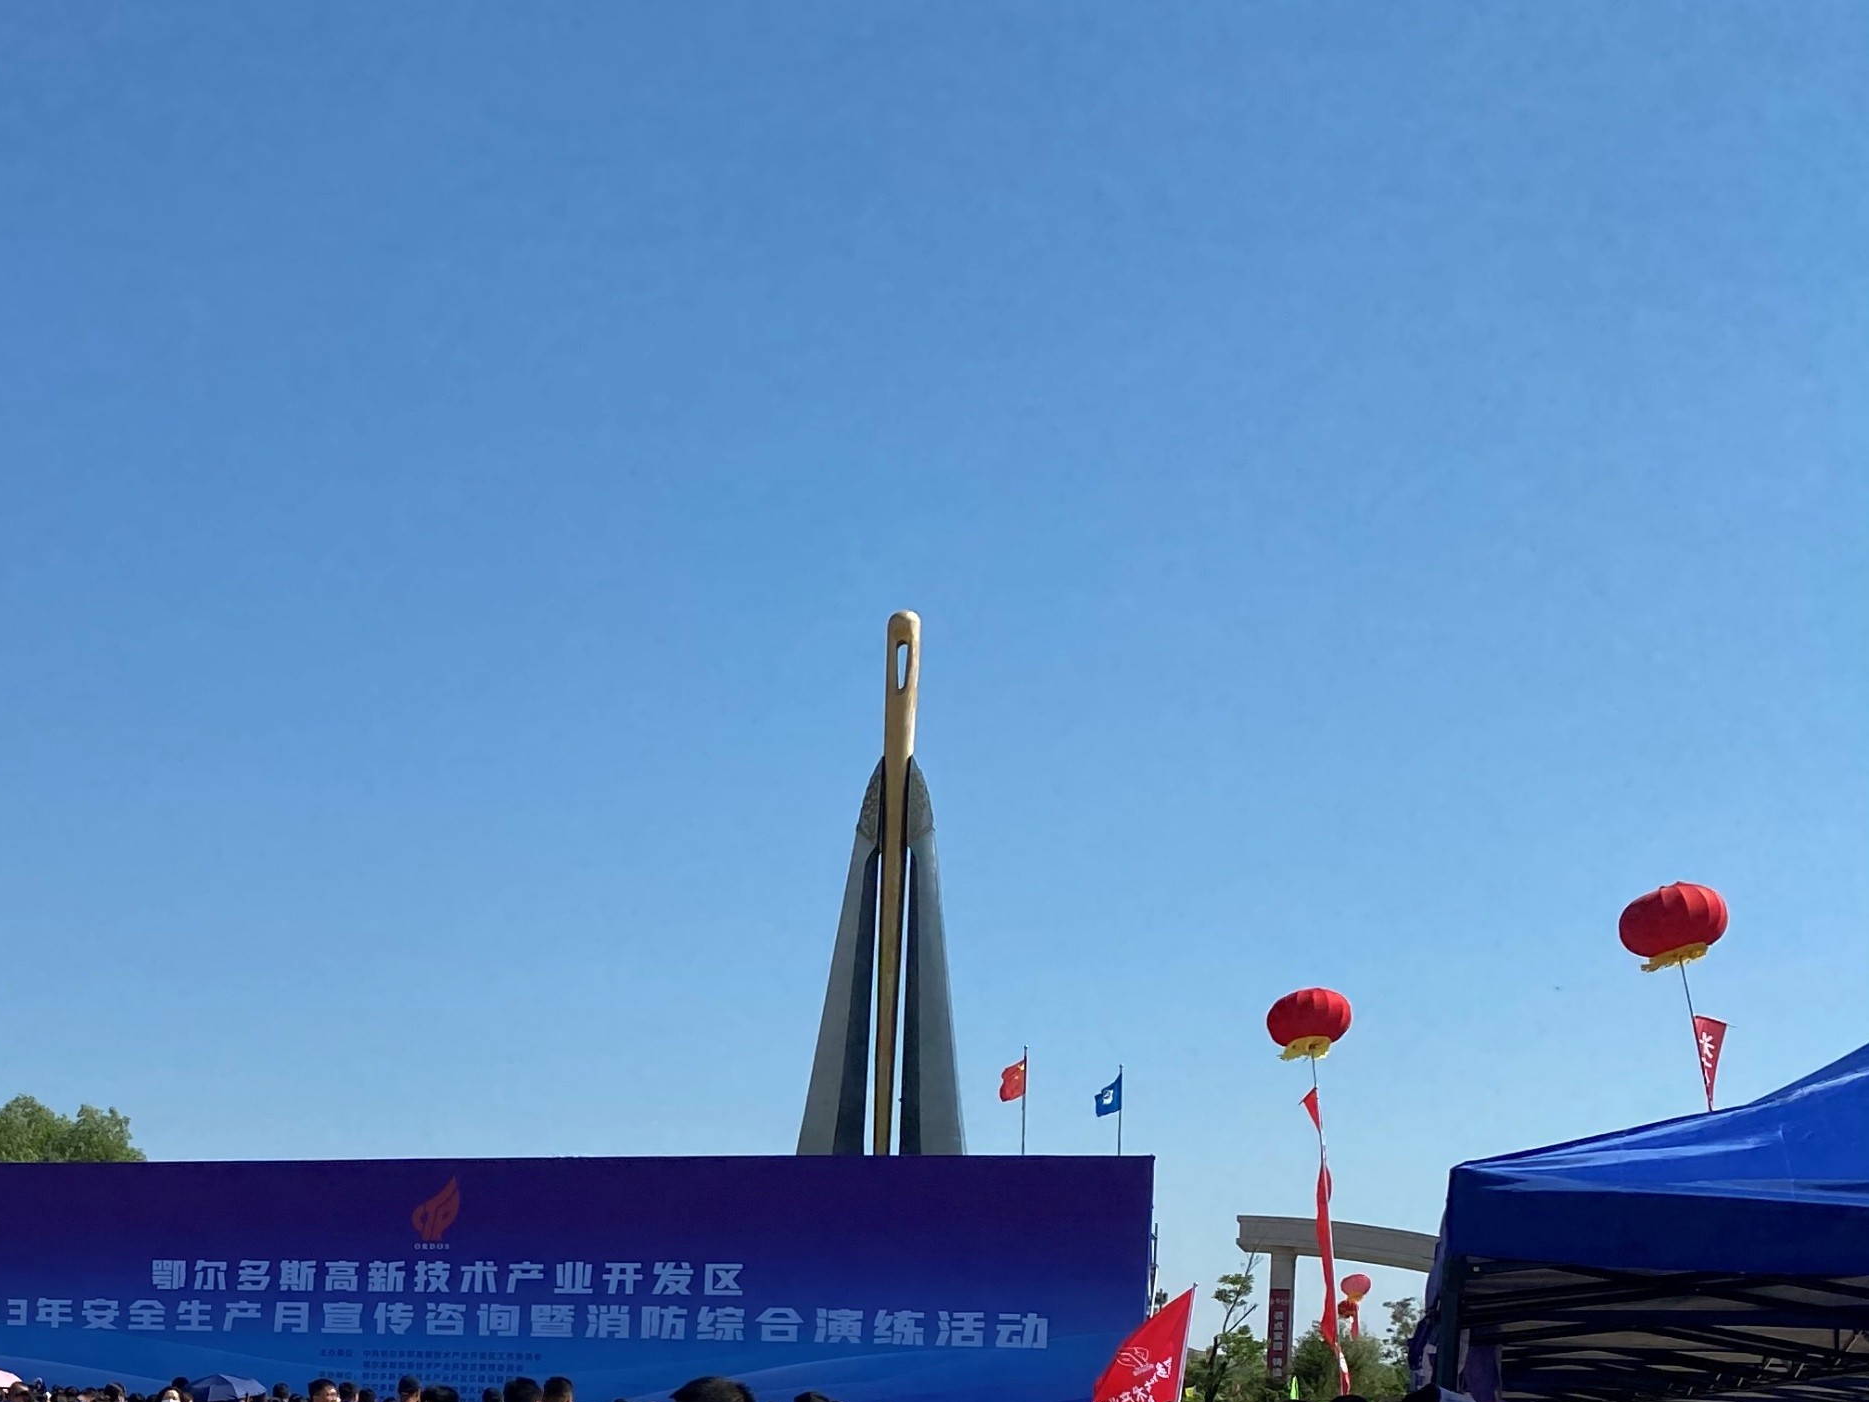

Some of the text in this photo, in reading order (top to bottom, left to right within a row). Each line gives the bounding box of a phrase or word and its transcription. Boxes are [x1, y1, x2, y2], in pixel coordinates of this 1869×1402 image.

[413, 1242, 450, 1250] ORDOS
[151, 1259, 745, 1296] 鄂尔多斯高新技术产业开发区
